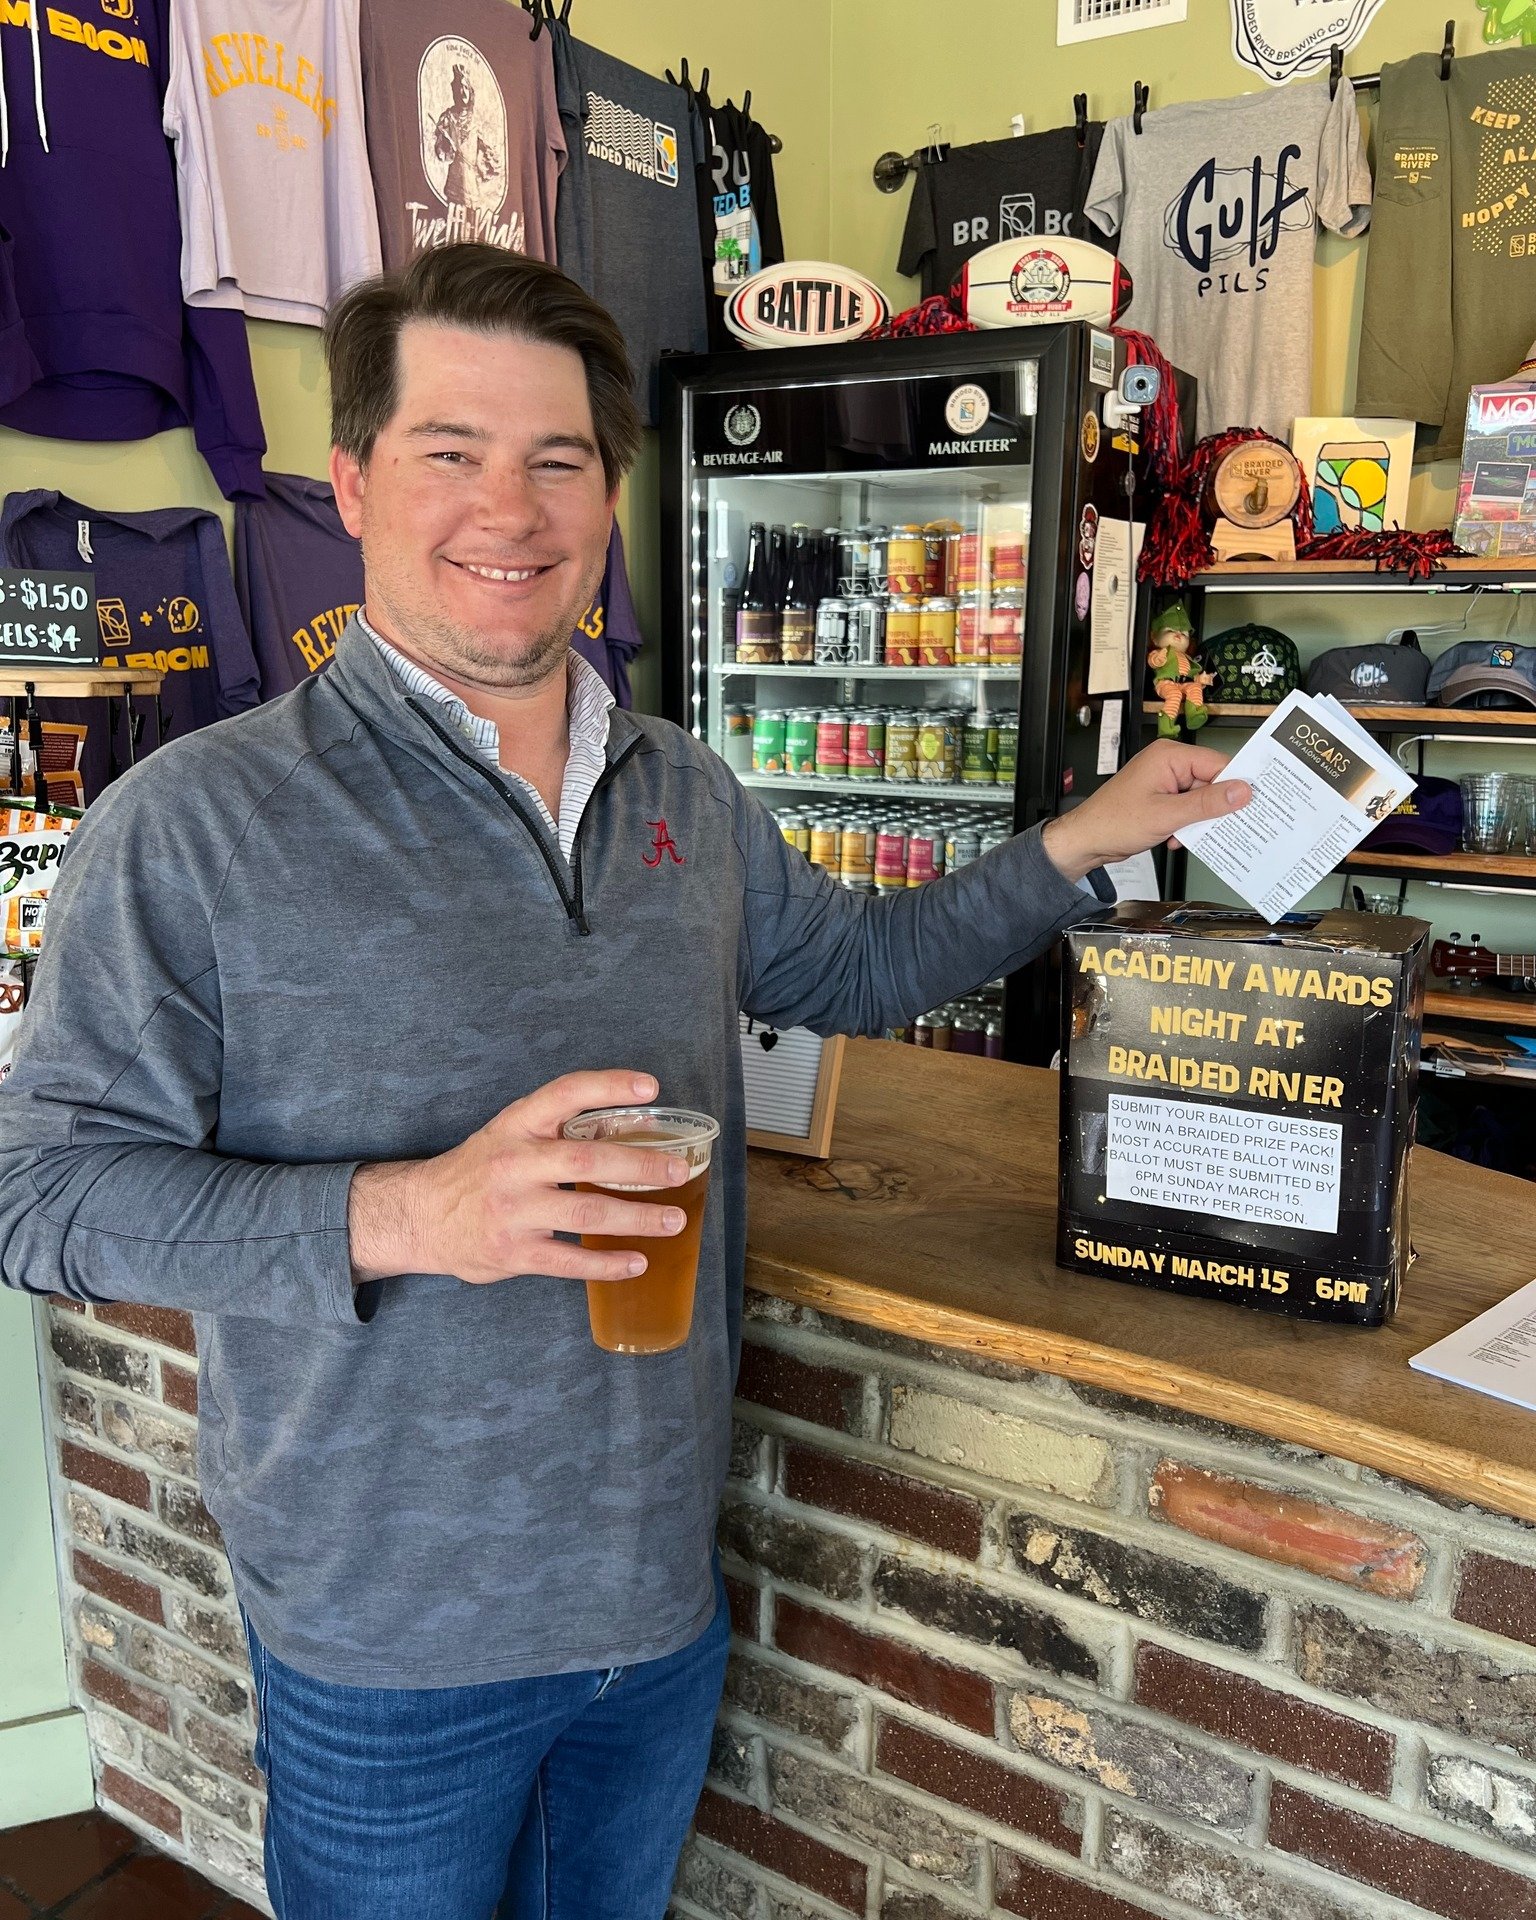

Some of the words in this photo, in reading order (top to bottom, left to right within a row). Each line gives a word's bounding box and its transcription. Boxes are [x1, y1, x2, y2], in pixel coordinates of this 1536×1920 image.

[1246, 0, 1259, 34] AIDED
[1253, 33, 1276, 59] RIVER
[1276, 28, 1326, 61] BREWING
[1470, 106, 1521, 129] KEEP
[584, 141, 622, 167] AIDED
[625, 157, 656, 180] RIVER
[1394, 152, 1439, 161] BRAIDED
[1400, 160, 1431, 169] RIVER
[1177, 144, 1308, 272] Gulf
[1462, 182, 1531, 228] HOPPY
[1197, 267, 1271, 297] PILS
[758, 280, 862, 333] BATTLE
[1481, 397, 1536, 422] MO
[702, 451, 783, 467] BEVERAGE-AIR
[1243, 459, 1284, 469] BRAIDED
[1243, 468, 1271, 476] RIVER
[1288, 735, 1303, 748] PLAY
[1301, 746, 1322, 764] ALONG
[1320, 761, 1341, 779] BALLOT
[1295, 724, 1351, 773] OSCARS
[1079, 946, 1236, 990] ACADEMY
[1243, 963, 1394, 1008] AWARDS
[1150, 1006, 1248, 1042] NIGHT
[1254, 1017, 1304, 1050] AT
[1108, 1046, 1240, 1094] BRAIDED
[1248, 1066, 1345, 1108] RIVER
[1111, 1099, 1162, 1116] SUBMIT
[1165, 1106, 1205, 1122] YOUR
[1209, 1112, 1263, 1130] BALLOT
[1267, 1120, 1339, 1141] GUESSES
[1113, 1116, 1132, 1129] TO
[1135, 1119, 1161, 1133] WIN
[1164, 1124, 1174, 1135] A
[1178, 1125, 1240, 1144] BRAIDED
[1244, 1134, 1286, 1151] PRIZE
[1290, 1141, 1334, 1158] PACK!
[1109, 1149, 1160, 1166] BALLOT
[1164, 1157, 1202, 1173] MUST
[1206, 1164, 1224, 1177] BE
[1229, 1167, 1311, 1190] SUBMITTED
[1315, 1181, 1335, 1194] BY
[1111, 1133, 1150, 1148] MOST
[1153, 1139, 1229, 1160] ACCURATE
[1233, 1150, 1288, 1168] BALLOT
[1292, 1159, 1334, 1176] WINS!
[1130, 1186, 1159, 1199] ONE
[1162, 1190, 1209, 1207] ENTRY
[1213, 1198, 1241, 1214] PER
[1244, 1204, 1308, 1225] PERSON.
[1135, 1170, 1163, 1184] 6PM
[1167, 1174, 1224, 1193] SUNDAY
[1228, 1184, 1279, 1202] MARCH
[1284, 1193, 1303, 1207] 15.
[1075, 1238, 1165, 1274] SUNDAY
[1171, 1256, 1254, 1288] MARCH
[1260, 1267, 1290, 1295] 15
[1315, 1277, 1370, 1304] 6PM
